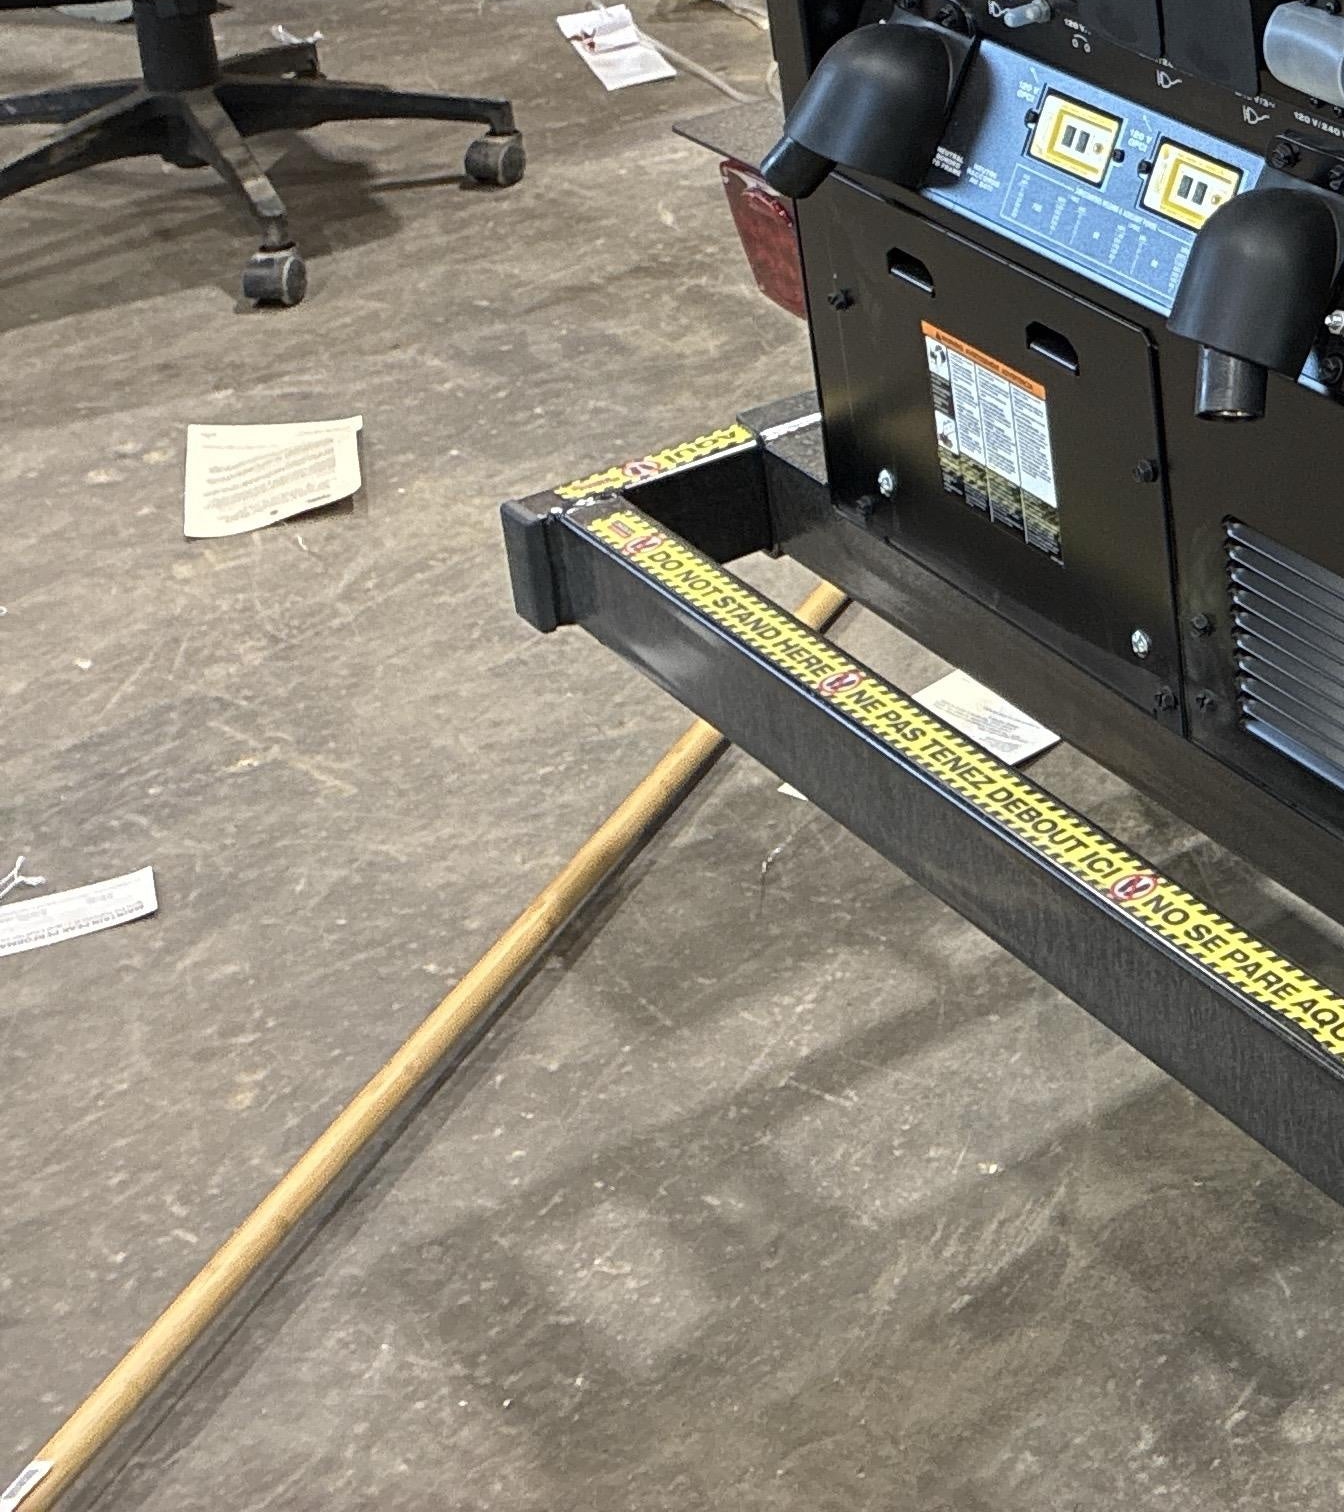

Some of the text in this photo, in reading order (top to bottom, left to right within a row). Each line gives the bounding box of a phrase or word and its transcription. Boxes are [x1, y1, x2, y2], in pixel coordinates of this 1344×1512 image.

[647, 550, 836, 679] DO NOT STAND HERE
[845, 688, 889, 715] NE
[875, 706, 928, 744] PAS
[918, 737, 999, 792] TENEZ
[985, 786, 1091, 854] DEBOUT
[1076, 851, 1125, 880] ICI
[1141, 894, 1191, 926] NO
[1183, 923, 1231, 954] SE
[1223, 947, 1303, 1002] PARE
